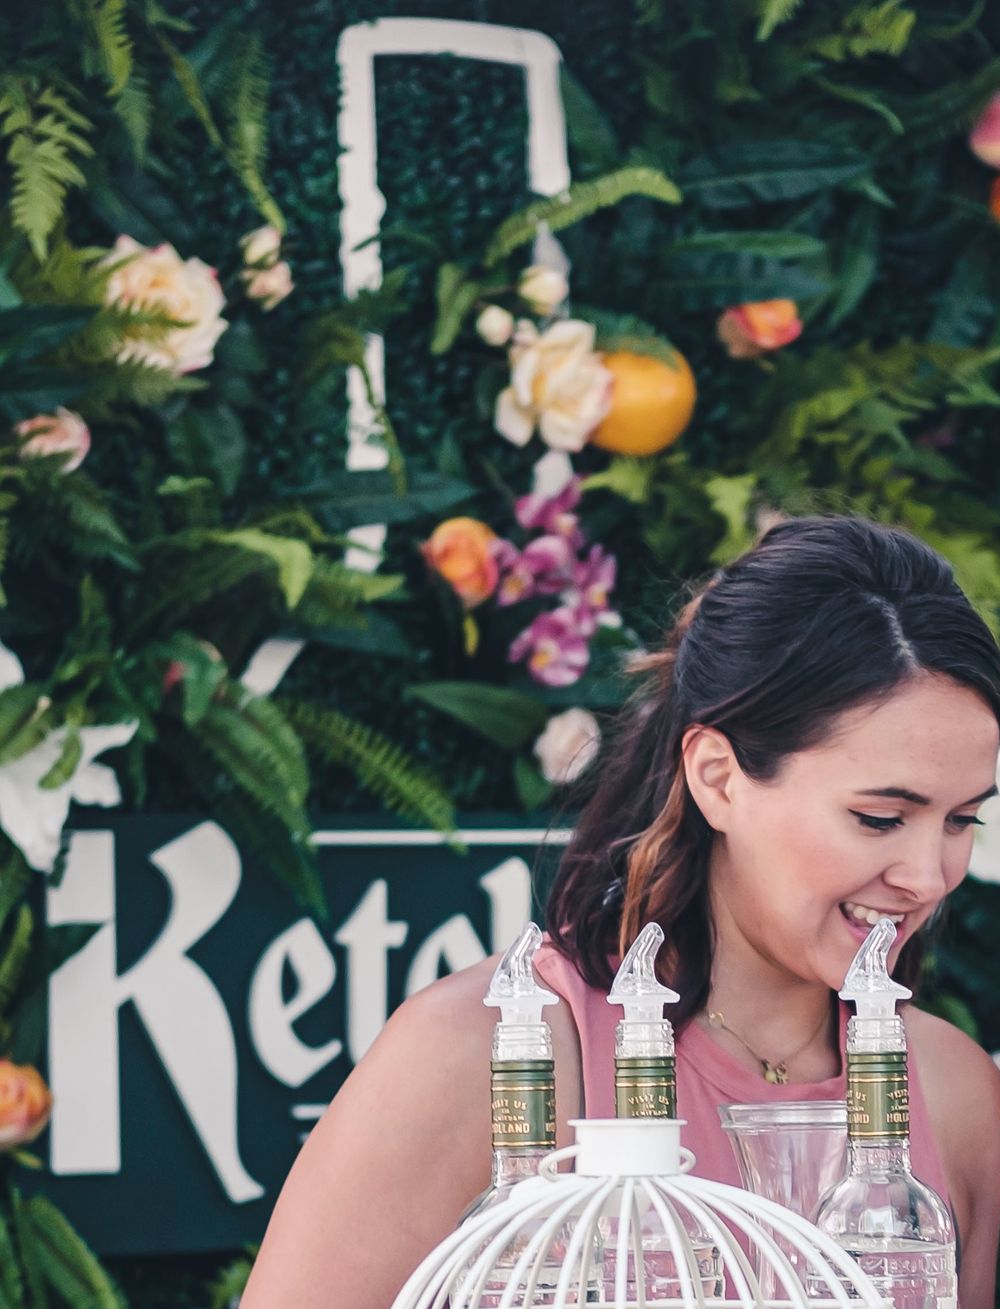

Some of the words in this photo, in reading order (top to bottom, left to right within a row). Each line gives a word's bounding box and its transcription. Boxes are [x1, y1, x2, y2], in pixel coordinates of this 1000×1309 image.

[628, 1094, 654, 1105] VISIT
[658, 1095, 670, 1105] US
[513, 1100, 527, 1111] US
